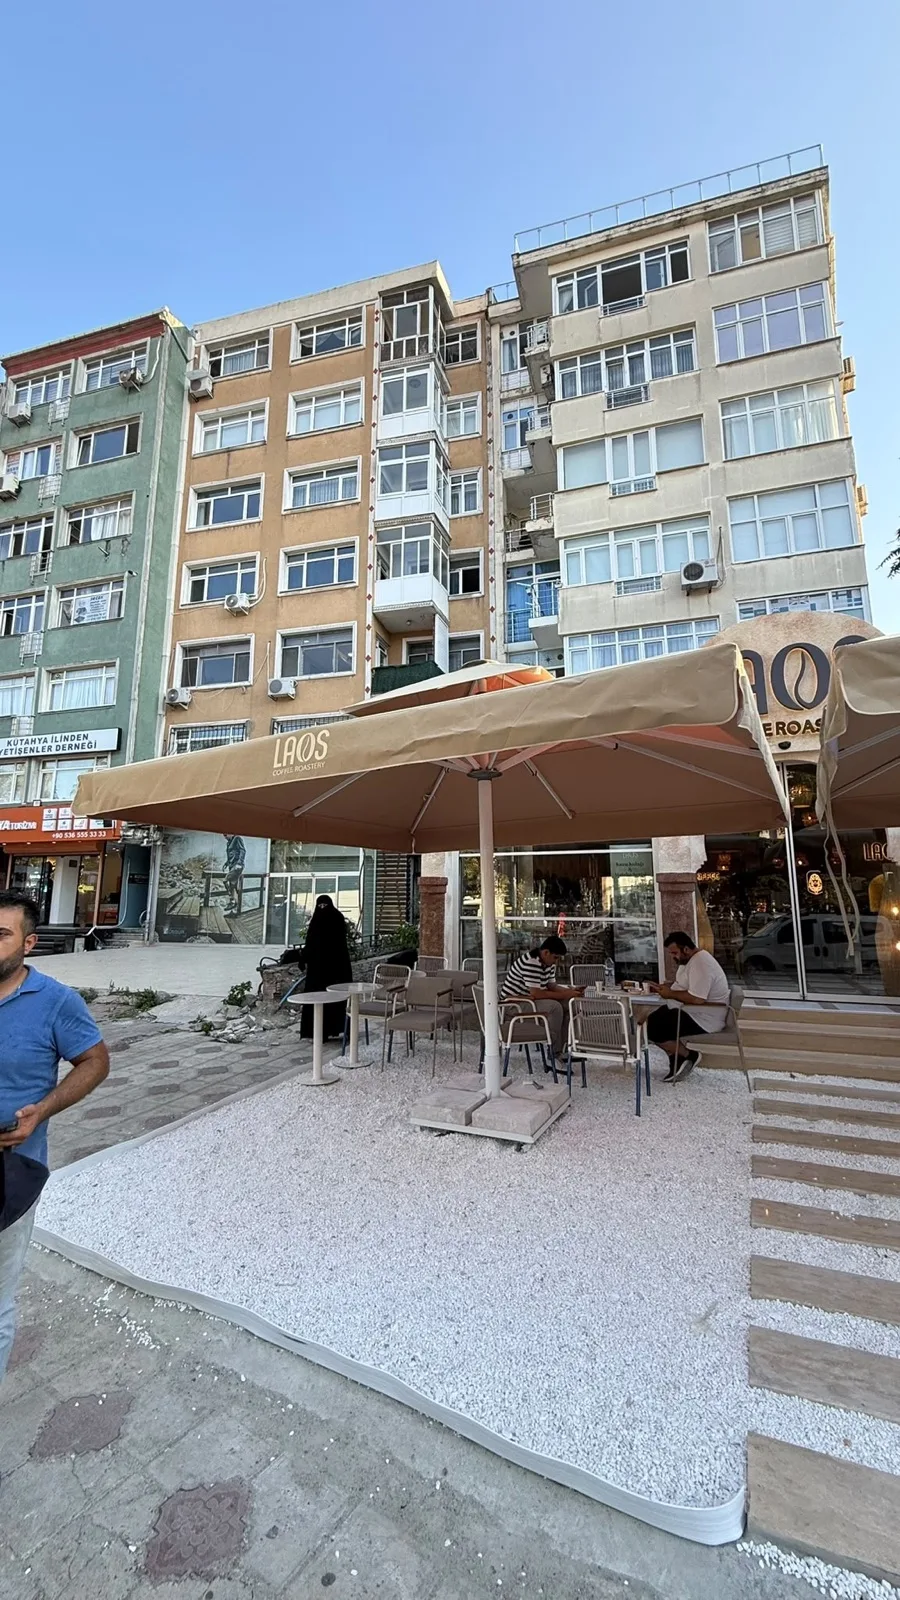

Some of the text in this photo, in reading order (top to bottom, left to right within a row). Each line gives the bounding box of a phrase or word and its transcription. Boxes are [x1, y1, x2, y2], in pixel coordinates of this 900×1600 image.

[6, 733, 89, 747] KÜTAHYA İLİNDEN
[55, 740, 97, 752] DERNEĞİ
[273, 729, 330, 769] LAOS
[294, 761, 326, 772] ROASTERY
[863, 842, 893, 861] LA
